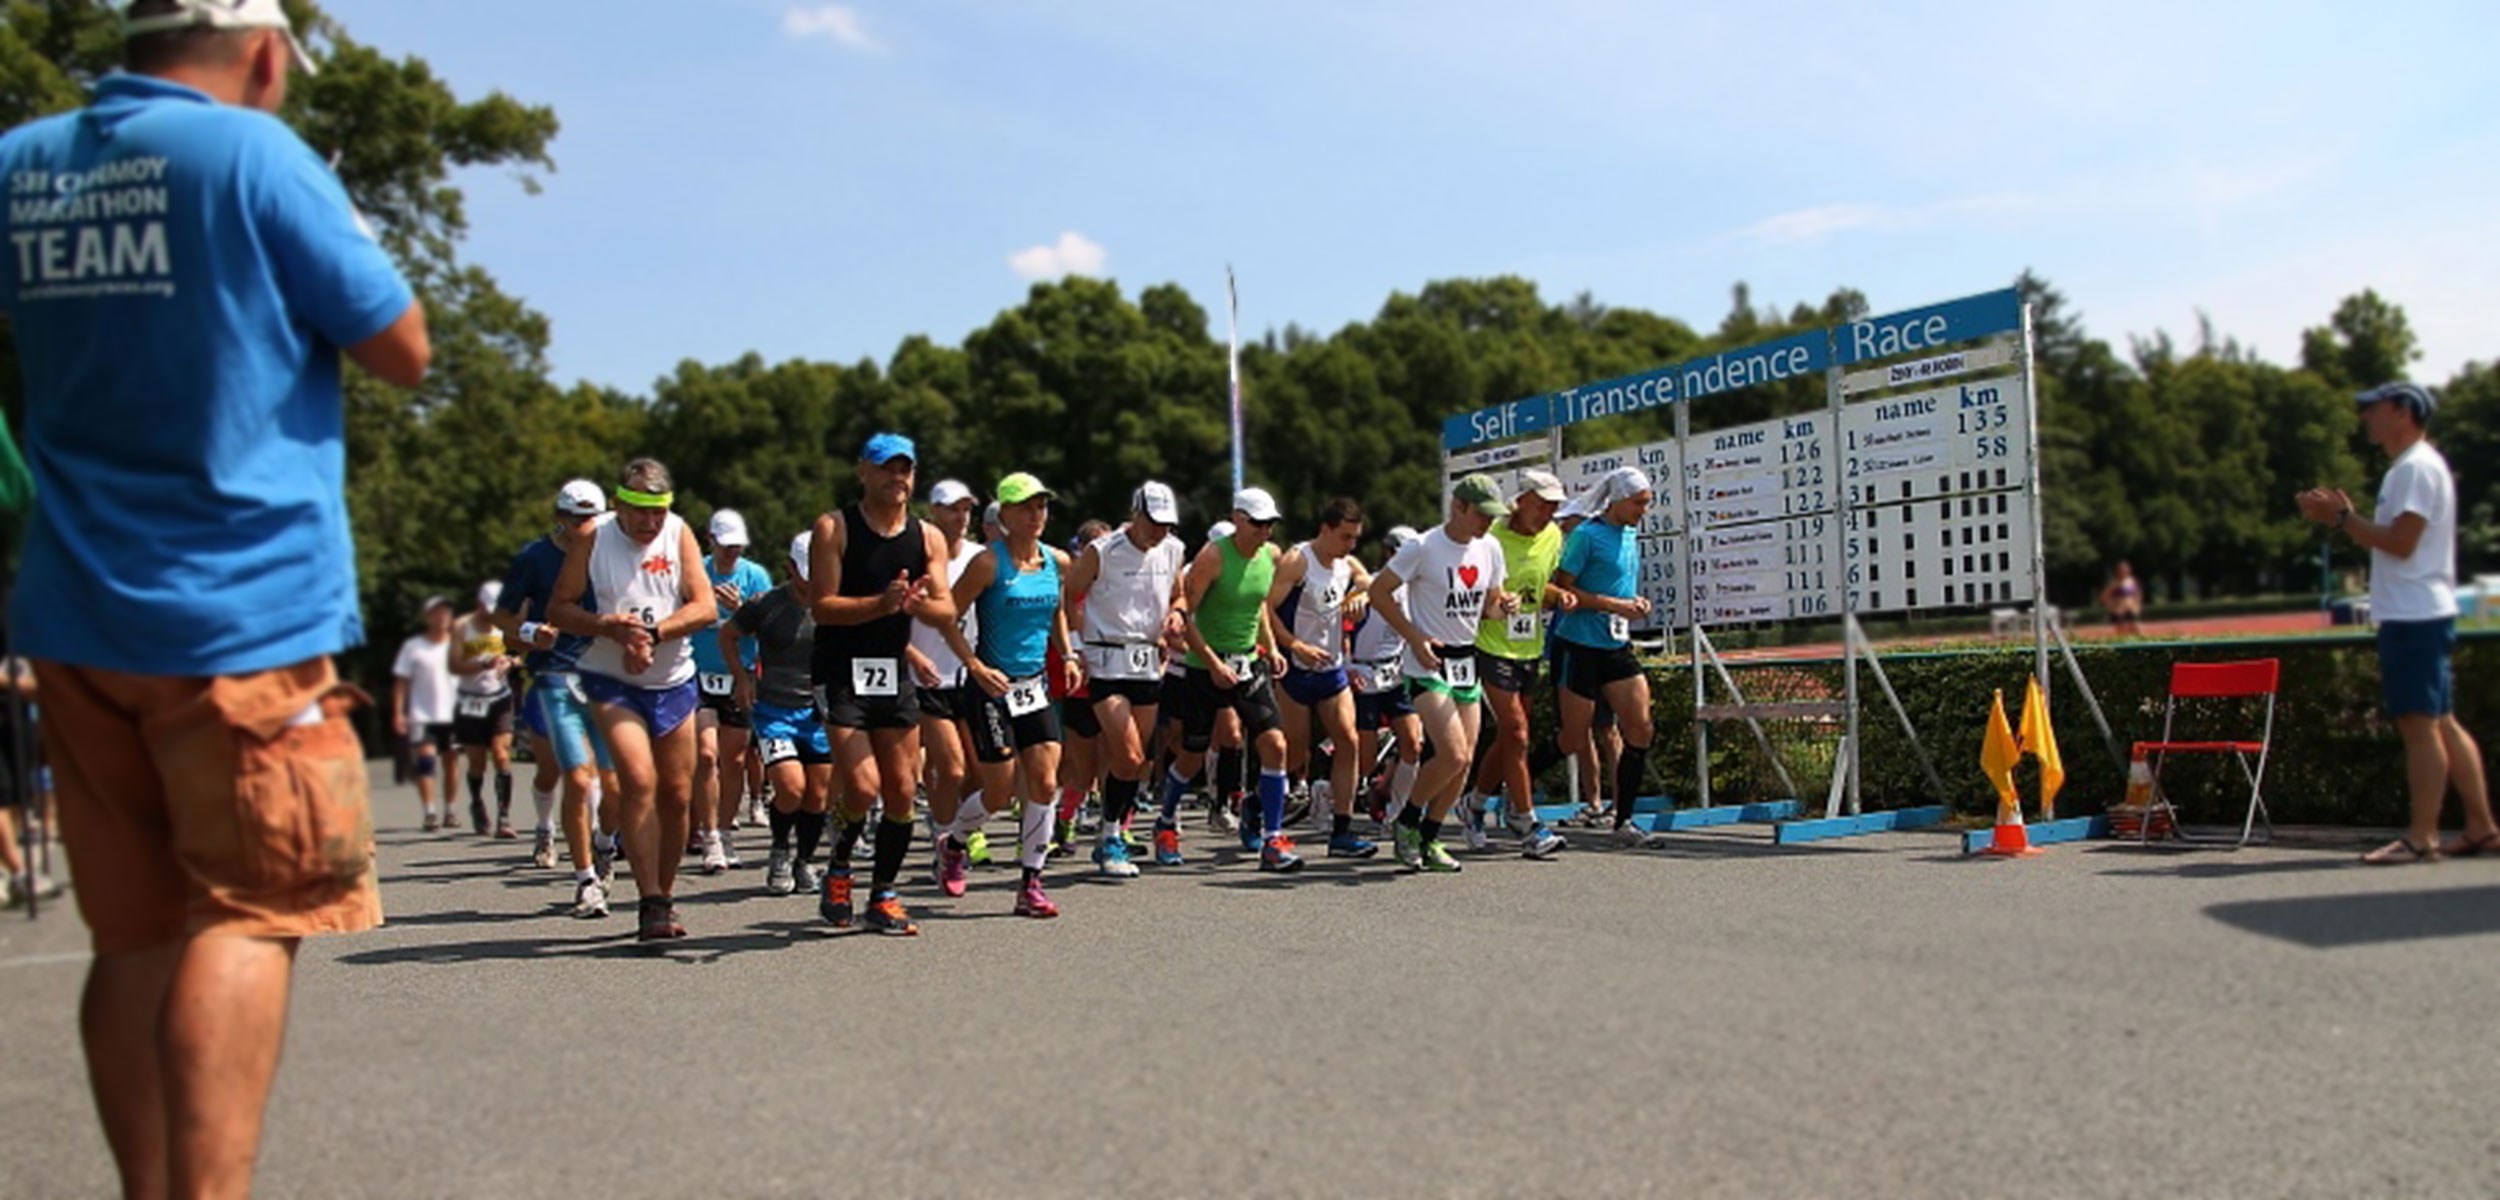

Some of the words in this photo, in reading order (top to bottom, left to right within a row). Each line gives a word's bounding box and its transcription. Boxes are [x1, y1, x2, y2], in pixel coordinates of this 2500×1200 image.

[10, 221, 171, 283] TEAM
[1853, 314, 1948, 361] Race
[1876, 397, 1937, 422] name
[1960, 386, 1999, 409] km
[1714, 430, 1765, 451] name
[1784, 420, 1814, 439] km
[1847, 430, 1856, 451] 1
[1958, 405, 2007, 434] 135
[1638, 447, 1665, 465] km
[1781, 439, 1821, 463] 126
[1847, 458, 1859, 478] 2
[1977, 436, 2007, 459] 58
[1782, 466, 1823, 489] 122
[1784, 491, 1824, 514] 122
[1848, 485, 1859, 502] 3
[1786, 517, 1824, 540] 119
[1847, 510, 1858, 531] 4
[1786, 544, 1823, 564] 111
[1847, 538, 1859, 558] 5
[1642, 562, 1675, 581] 130
[1786, 571, 1823, 591] 111
[1848, 563, 1860, 583] 6
[1788, 595, 1827, 617] 106
[1849, 591, 1860, 612] 7
[864, 667, 887, 687] 72
